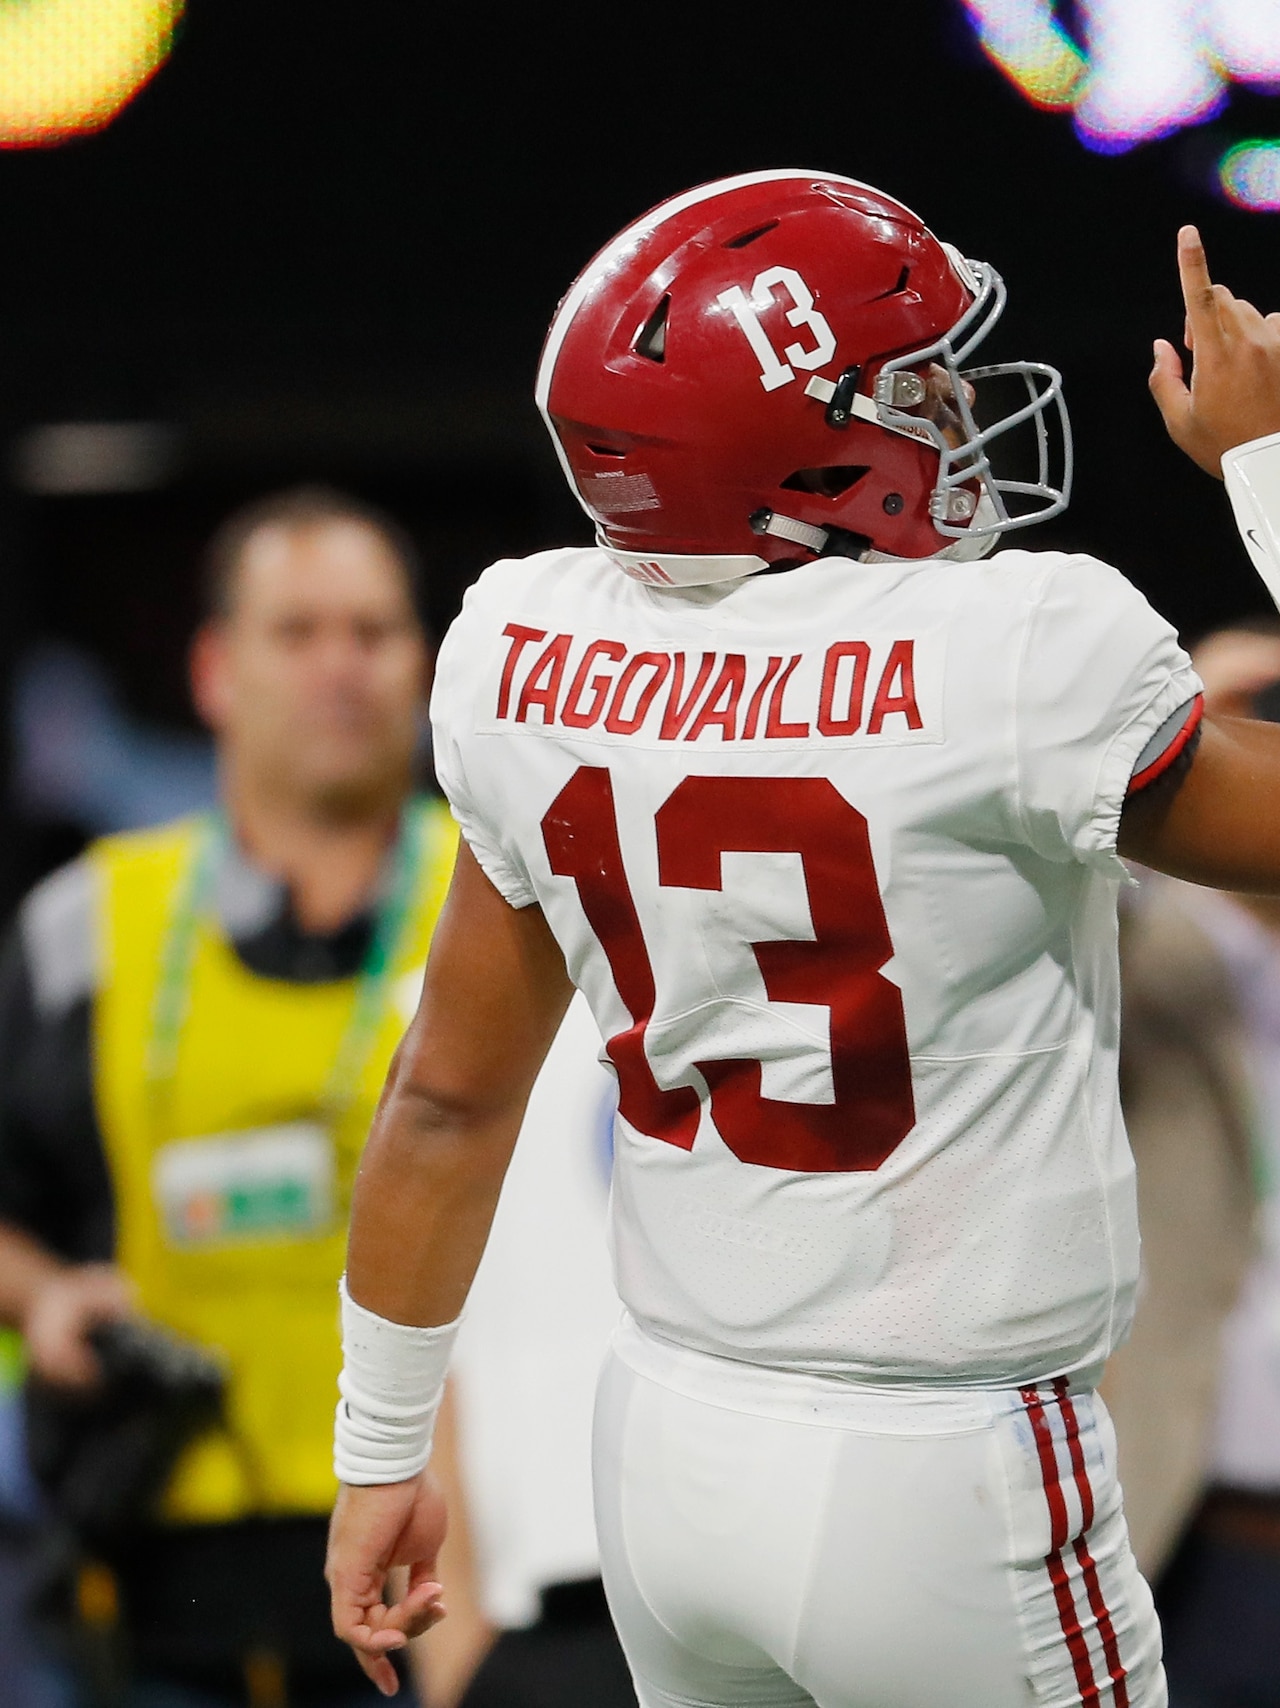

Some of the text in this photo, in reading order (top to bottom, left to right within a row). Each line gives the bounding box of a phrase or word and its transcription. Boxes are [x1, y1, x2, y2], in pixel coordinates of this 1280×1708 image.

[716, 265, 838, 392] 13
[496, 623, 924, 741] TAGOVAILOA
[540, 765, 917, 1172] 13
